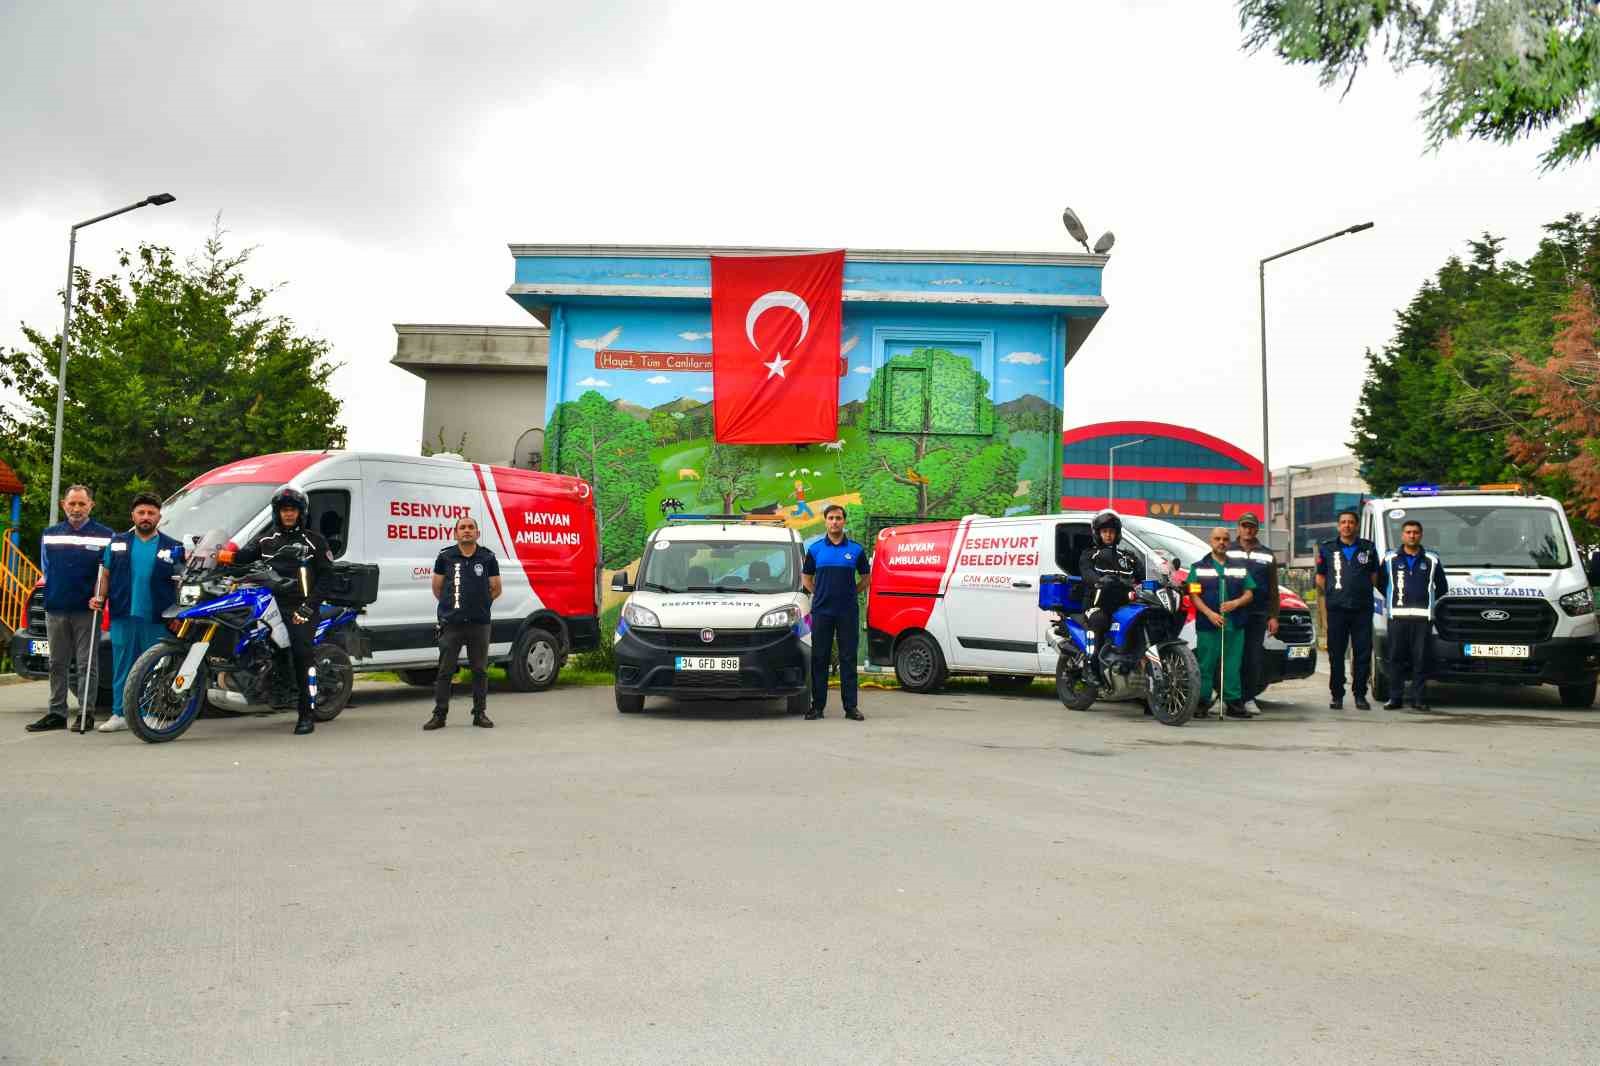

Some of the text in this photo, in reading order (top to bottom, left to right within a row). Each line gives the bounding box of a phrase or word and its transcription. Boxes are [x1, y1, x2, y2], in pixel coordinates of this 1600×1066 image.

[640, 355, 661, 368] Tüm
[390, 501, 471, 519] ESENYURT
[524, 511, 570, 526] HAYVAN
[515, 530, 581, 545] AMBULANSI
[965, 536, 1039, 550] ESENYURT
[897, 542, 935, 553] HAYVAN
[888, 555, 941, 566] AMBULANSI
[960, 551, 1040, 567] BELEDİYESİ
[1448, 587, 1545, 597] SENYURT ZABITA
[1472, 646, 1482, 656] 34
[682, 658, 738, 669] 34 GFD 898
